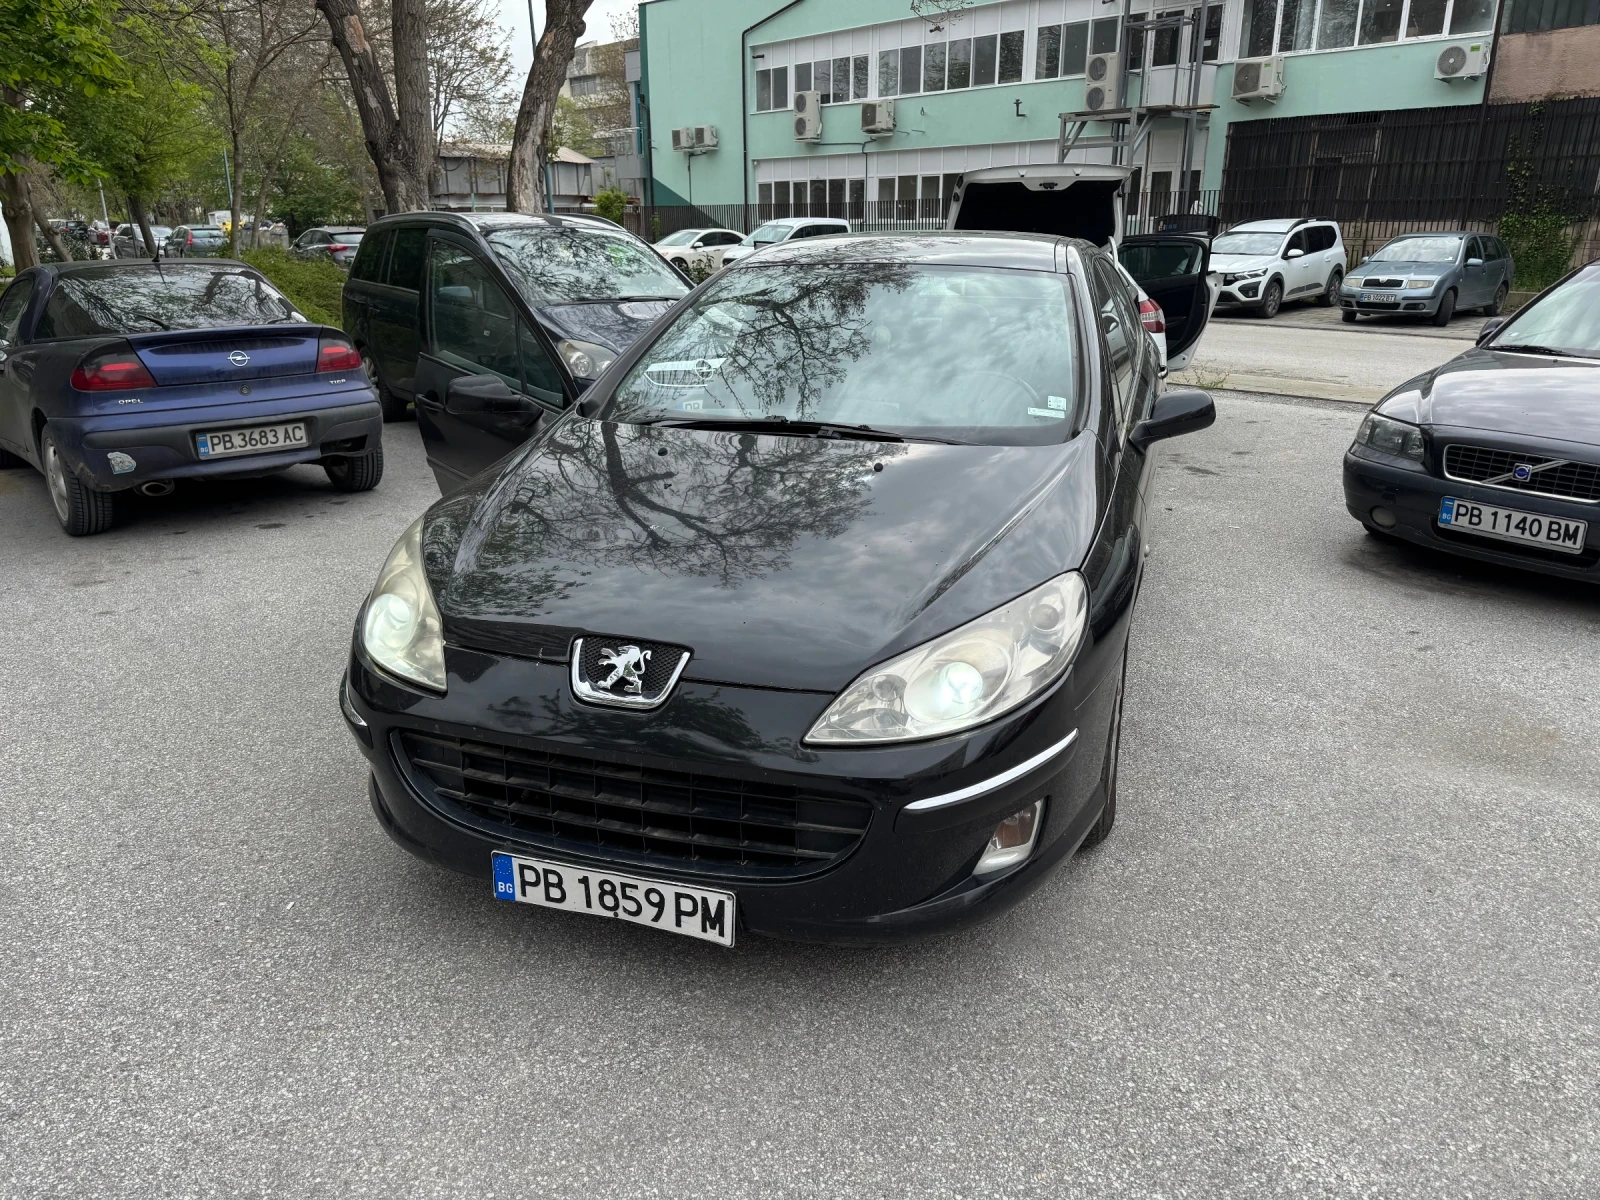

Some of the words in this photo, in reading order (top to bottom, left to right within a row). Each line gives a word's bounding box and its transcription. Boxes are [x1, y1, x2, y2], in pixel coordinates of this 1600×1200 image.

[209, 433, 235, 452] PB
[237, 428, 280, 449] 3683
[283, 425, 304, 443] AC
[1442, 512, 1451, 521] BG
[1454, 503, 1482, 526] PB
[1491, 510, 1542, 537] 1140
[1546, 520, 1580, 545] BM
[498, 881, 514, 894] BG
[518, 863, 567, 904] PB
[577, 875, 666, 923] 1859
[674, 891, 725, 938] PM
